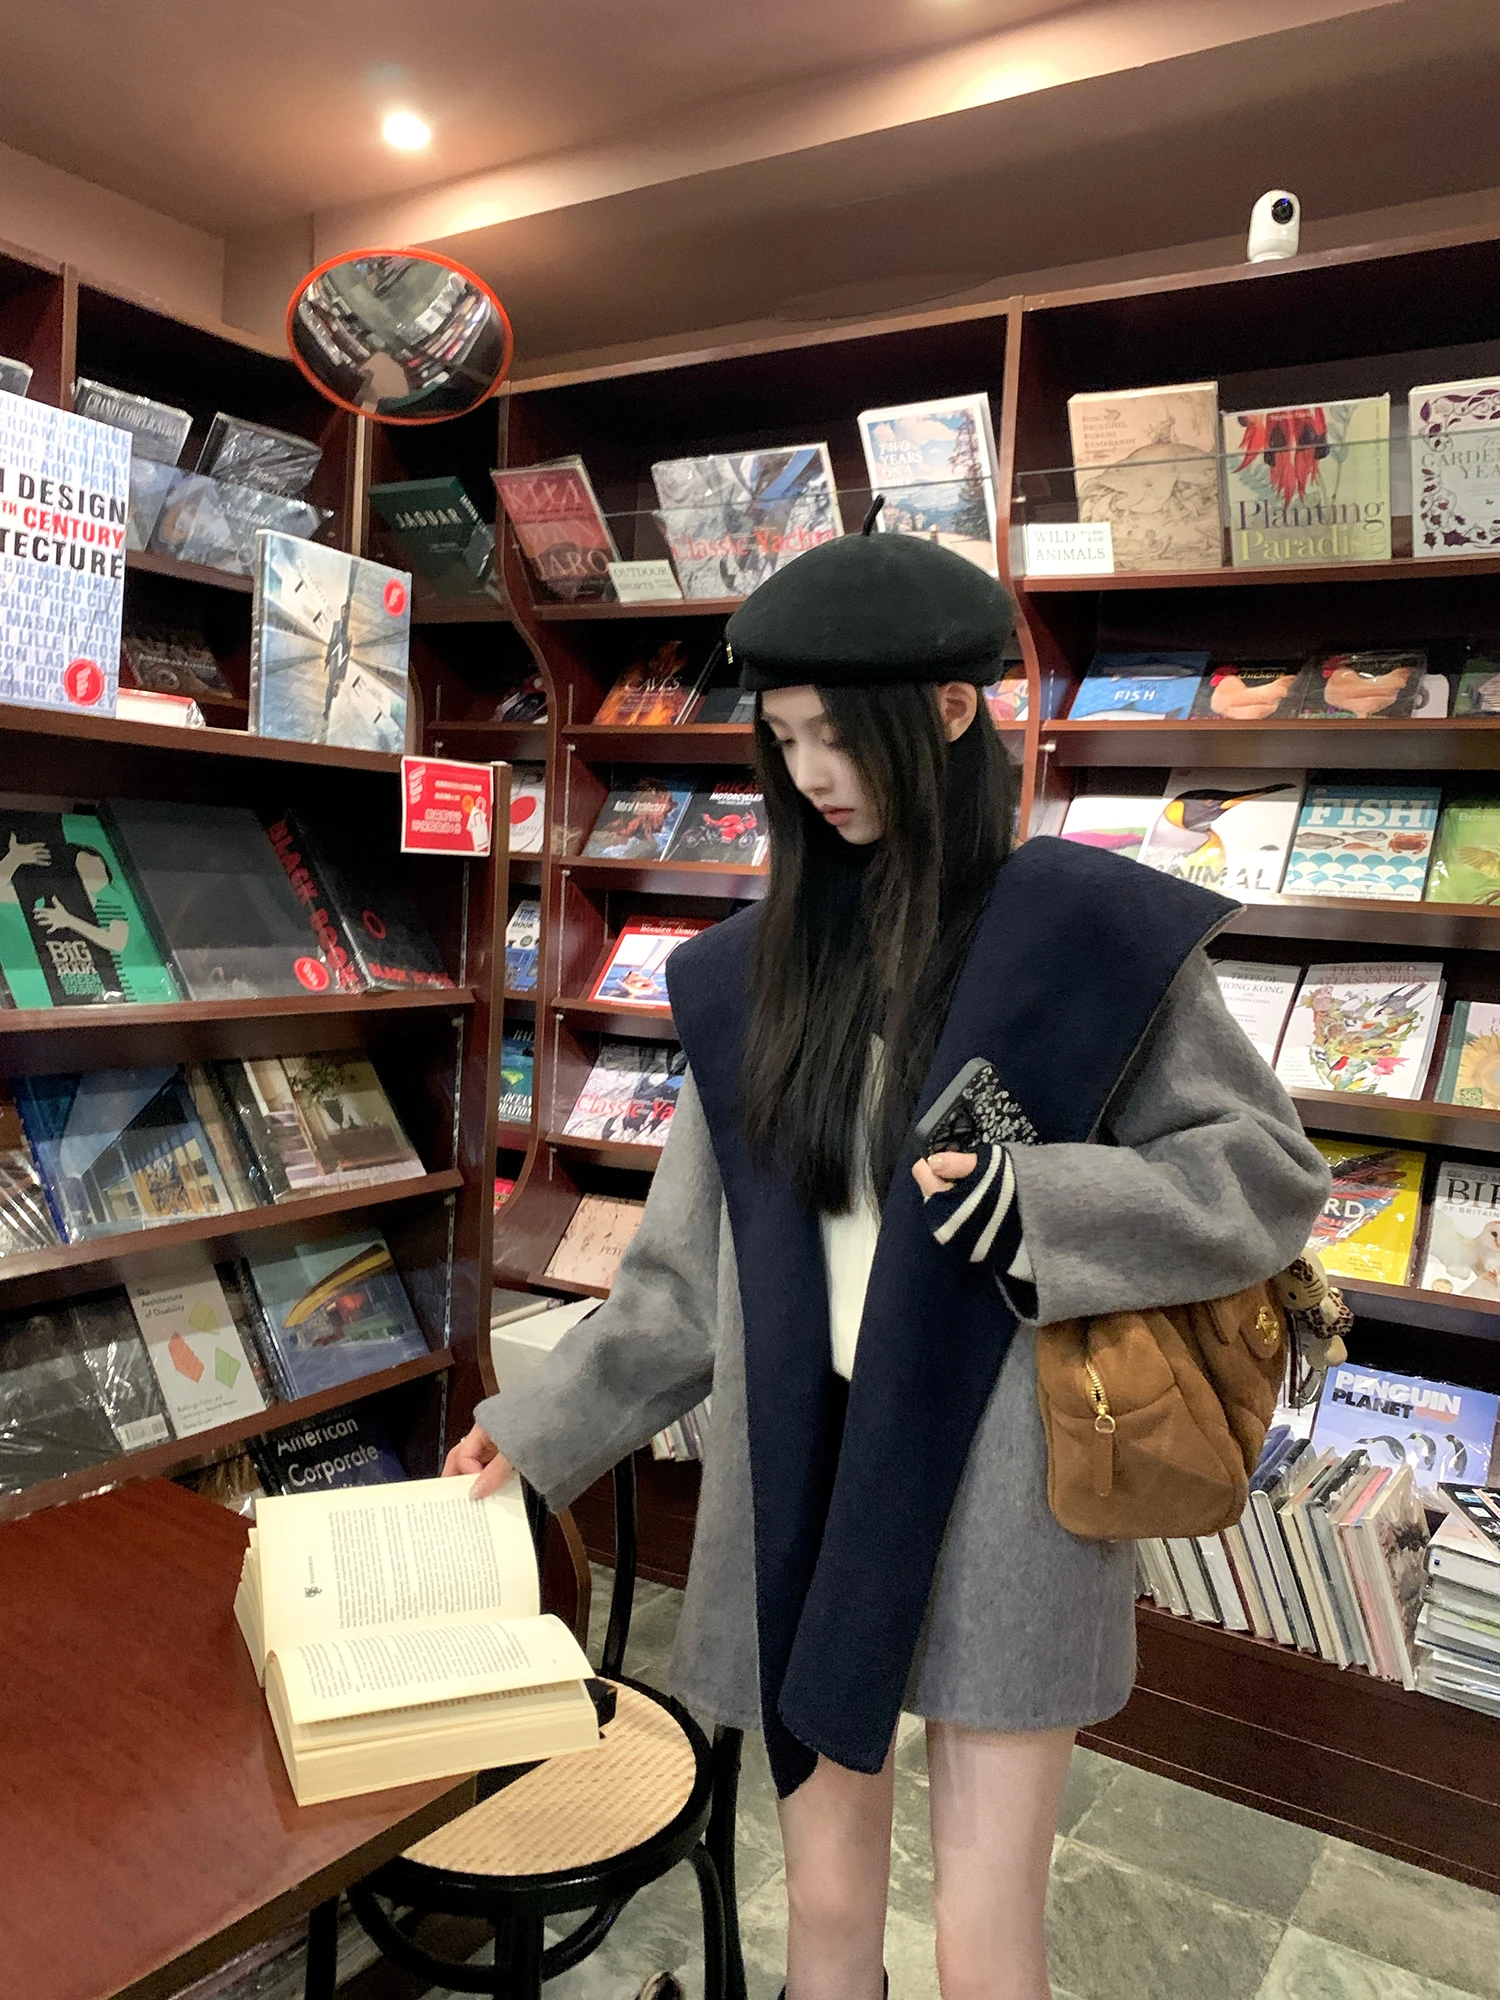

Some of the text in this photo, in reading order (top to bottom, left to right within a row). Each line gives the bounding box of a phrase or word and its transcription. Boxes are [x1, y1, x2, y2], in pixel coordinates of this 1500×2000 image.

[878, 440, 911, 456] TWO
[878, 450, 925, 465] YEARS
[18, 473, 126, 525] DESIGN
[23, 505, 126, 549] CENTURY
[1238, 500, 1386, 534] Planting
[670, 532, 750, 561] Classic
[1035, 530, 1077, 543] WILD
[1240, 524, 1387, 562] Paradise
[1035, 547, 1106, 561] ANIMALS
[4, 557, 71, 587] BUENOS
[18, 577, 121, 612] MEXICO CITY
[49, 601, 121, 630] HELSINKI
[84, 624, 120, 646] CITY
[1113, 690, 1156, 701] FISH
[1307, 797, 1427, 828] FISH
[267, 820, 320, 906] BLACK
[1170, 864, 1271, 890] NIMAL
[45, 940, 93, 963] BIG
[1231, 972, 1262, 981] TREES
[1316, 974, 1433, 985] ATLAS OF BIRDS
[1331, 964, 1418, 976] THE WORLD
[1252, 984, 1285, 995] KONG
[576, 1093, 646, 1119] Classic
[1441, 1204, 1456, 1213] OF
[141, 1293, 183, 1308] Architecture
[145, 1309, 153, 1319] of
[1331, 1388, 1414, 1420] PLANET
[1335, 1369, 1462, 1416] PENGUIN
[276, 1417, 360, 1457] American
[287, 1444, 380, 1488] Corporate
